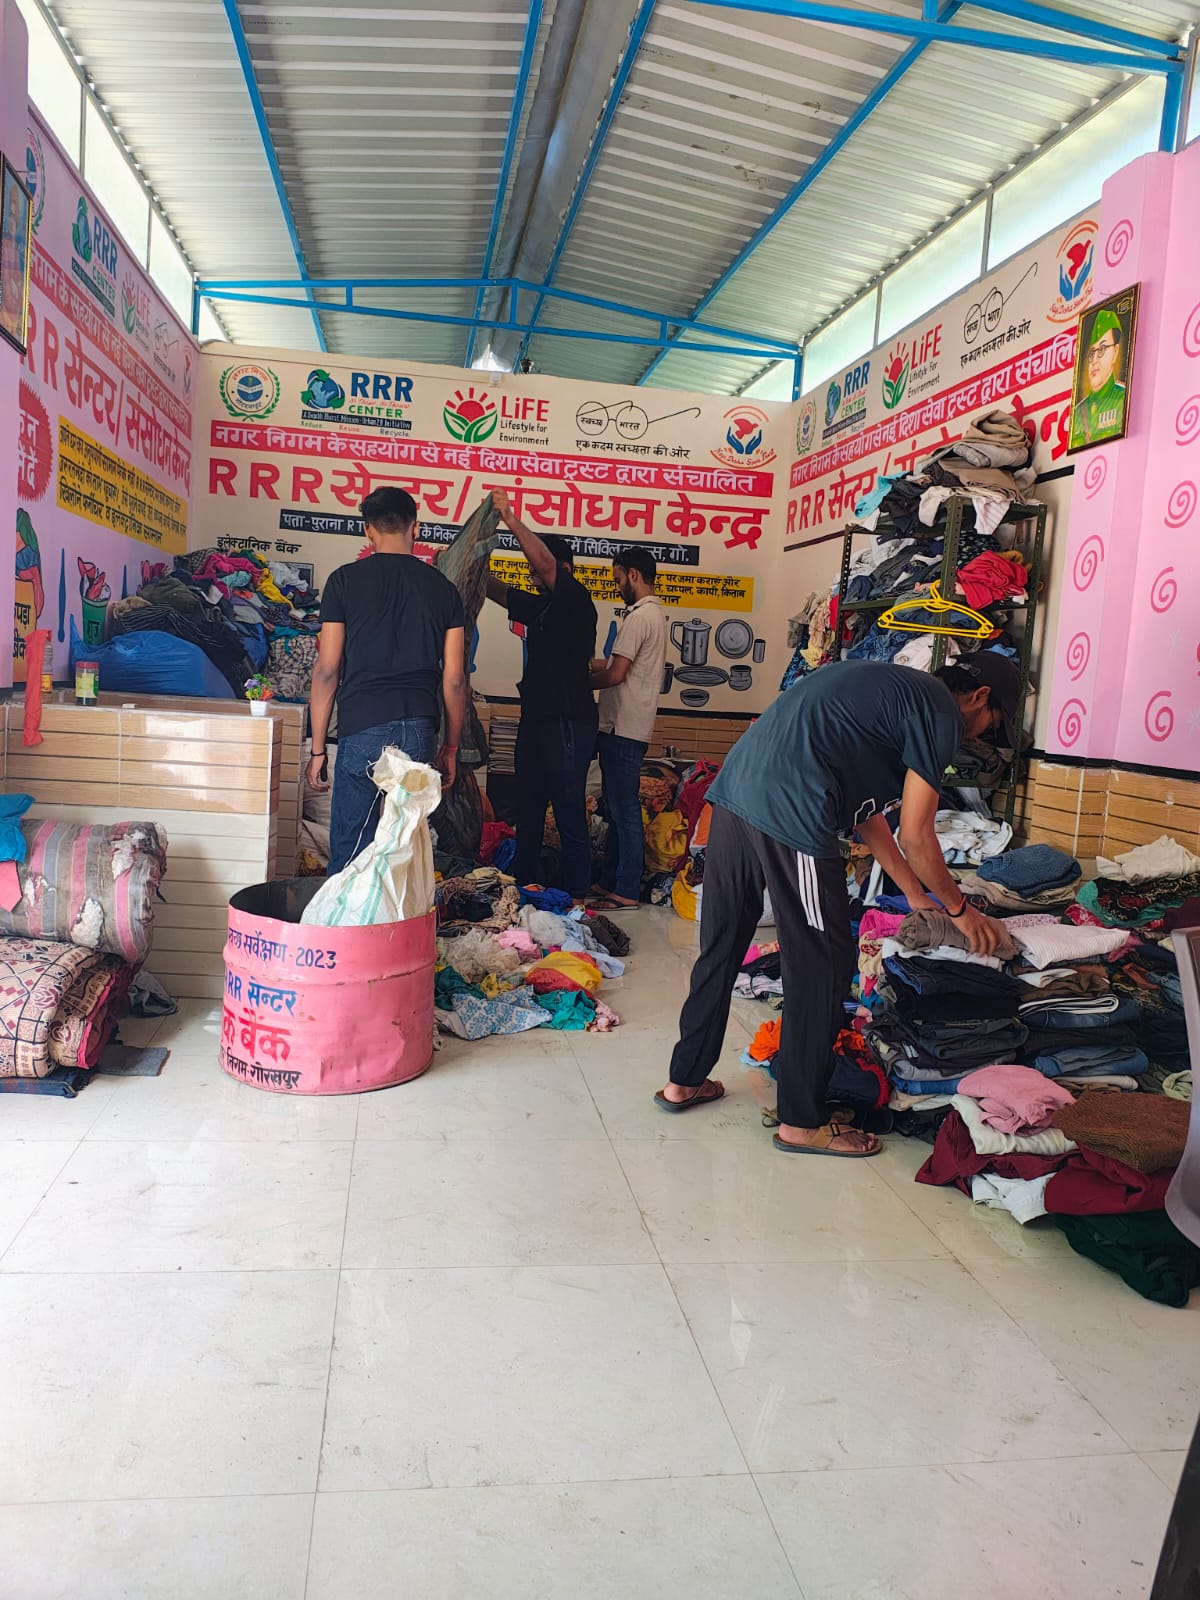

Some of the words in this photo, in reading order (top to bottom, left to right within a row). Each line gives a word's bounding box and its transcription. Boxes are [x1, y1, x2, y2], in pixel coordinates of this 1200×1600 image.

[93, 216, 117, 280] RRR
[911, 324, 943, 370] LiFE
[1015, 333, 1078, 385] संचालि
[351, 372, 414, 403] RRR
[843, 361, 870, 398] RRR
[349, 404, 403, 418] CENTER
[501, 395, 550, 422] LiFE
[499, 432, 549, 446] Environment
[500, 419, 535, 433] Lifestyle
[215, 425, 261, 446] नगर
[264, 426, 325, 452] निगम
[326, 432, 348, 454] के
[349, 437, 419, 462] सहयोग
[420, 441, 441, 464] से
[444, 445, 476, 469] नई
[478, 447, 520, 472] दिशा
[520, 451, 562, 475] सेवा
[562, 458, 613, 480] ट्रस्ट
[615, 463, 658, 484] द्वारा
[662, 465, 757, 493] संचालित
[591, 441, 613, 451] कदम
[651, 444, 668, 457] की
[666, 492, 770, 550] केन्द्र
[786, 489, 825, 534] RRR
[275, 539, 302, 554] बैंक
[421, 523, 433, 538] के
[296, 948, 336, 969] 2023
[226, 970, 242, 1001] RR
[248, 976, 298, 1017] सेन्टर
[239, 1007, 292, 1063] बैंक
